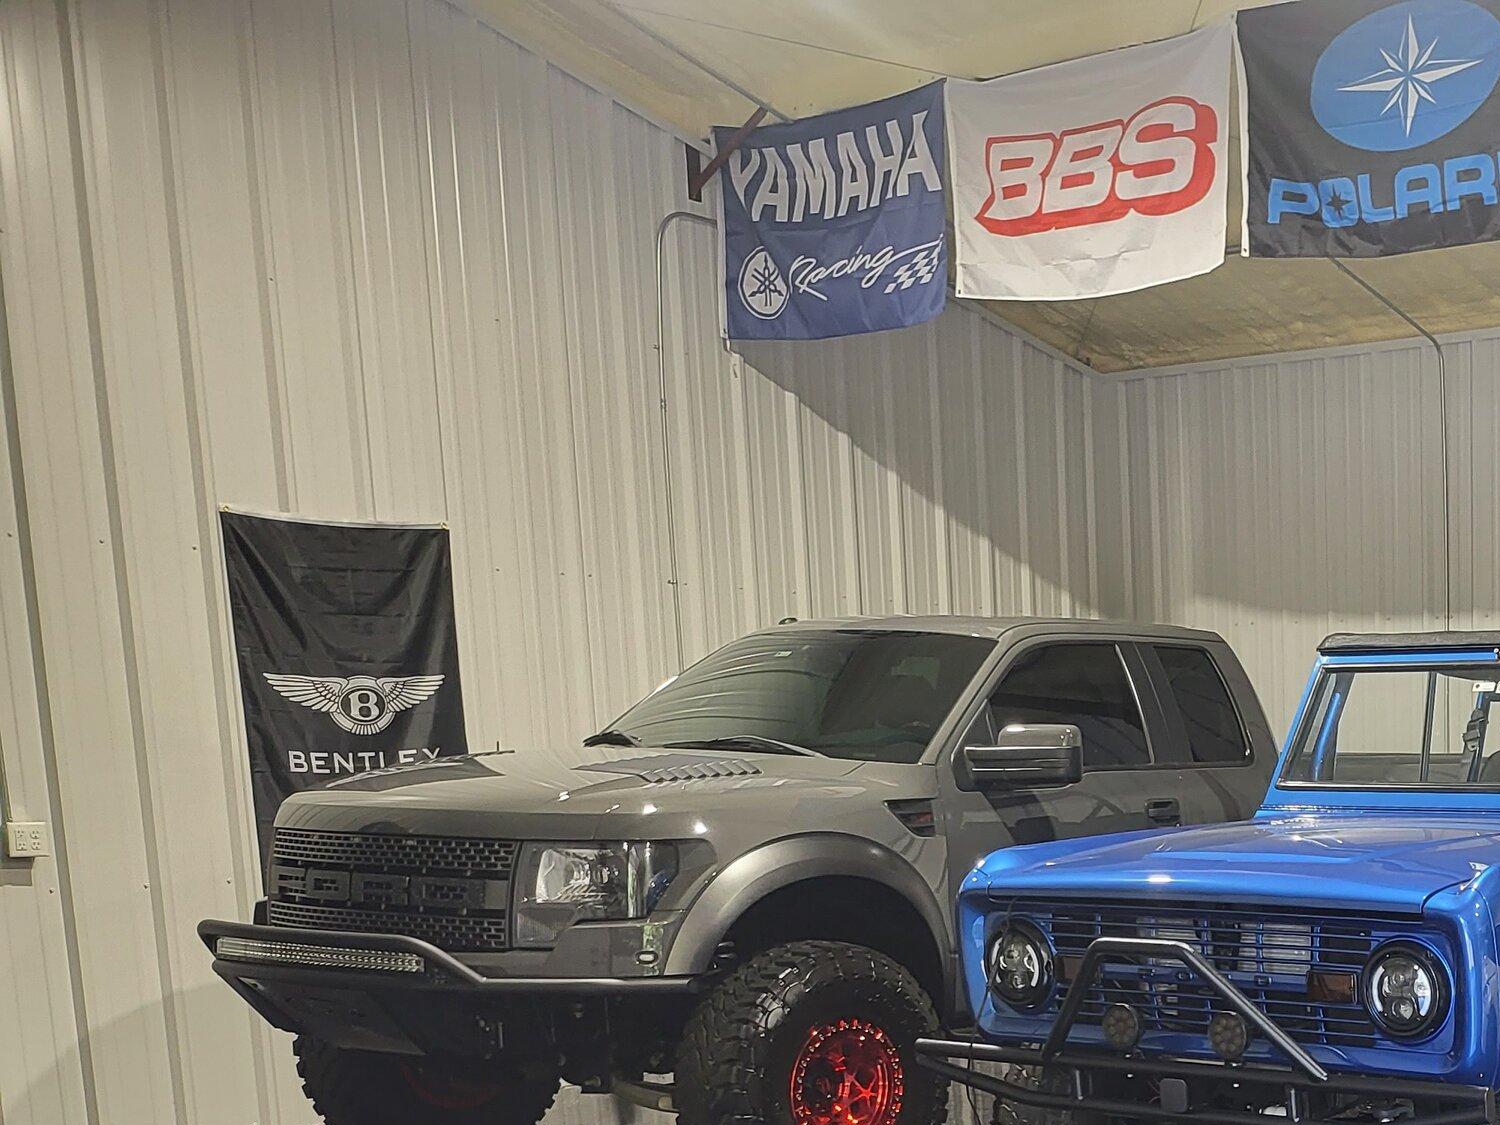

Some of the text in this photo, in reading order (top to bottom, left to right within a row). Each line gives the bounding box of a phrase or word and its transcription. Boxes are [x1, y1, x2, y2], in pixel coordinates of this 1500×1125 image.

[728, 110, 943, 223] YAMAHA
[976, 97, 1216, 234] BBS
[789, 245, 905, 301] Racing
